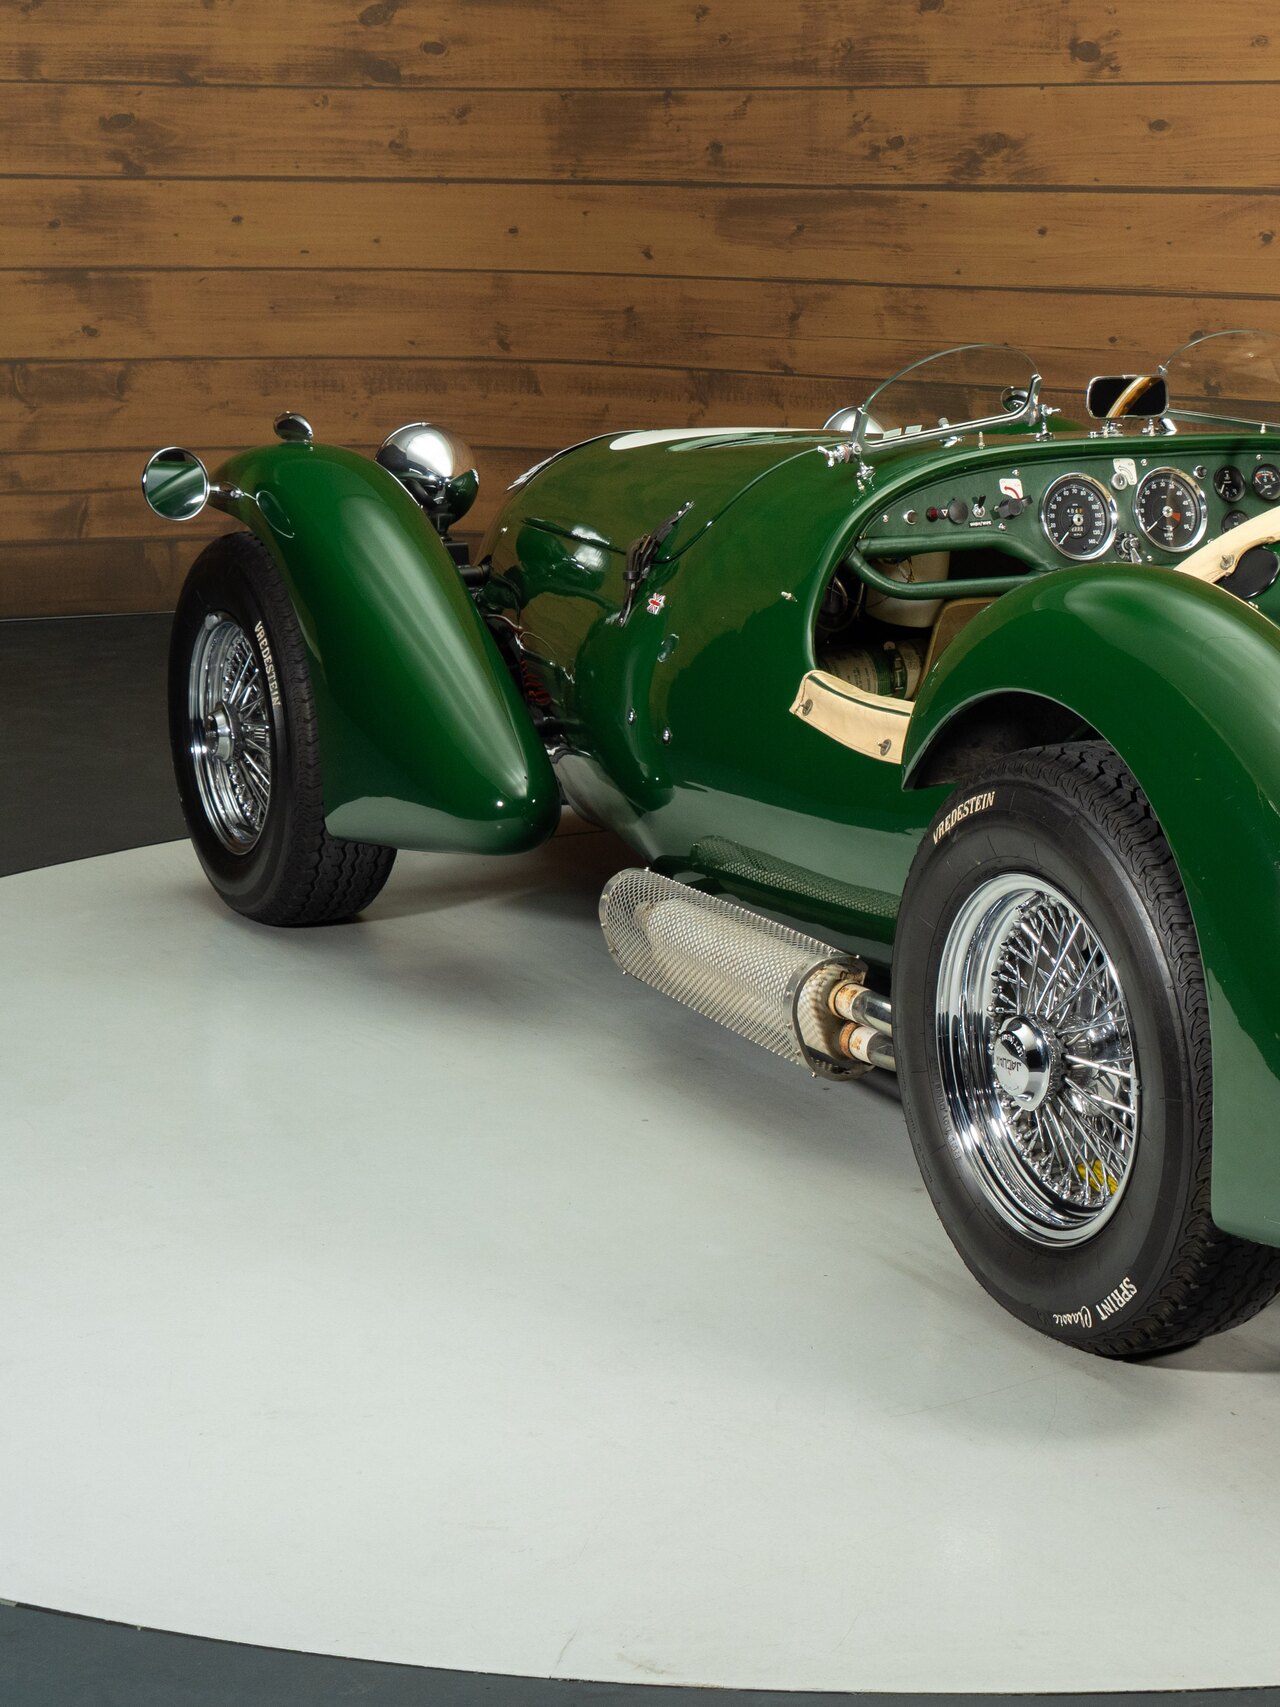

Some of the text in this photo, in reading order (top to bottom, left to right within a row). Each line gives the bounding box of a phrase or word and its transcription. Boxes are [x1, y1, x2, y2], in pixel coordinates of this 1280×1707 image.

[254, 620, 282, 707] VREDESTEIN
[933, 791, 996, 845] VREDESTEIN
[1052, 1305, 1093, 1329] Classic
[1095, 1276, 1138, 1321] SPRINT
